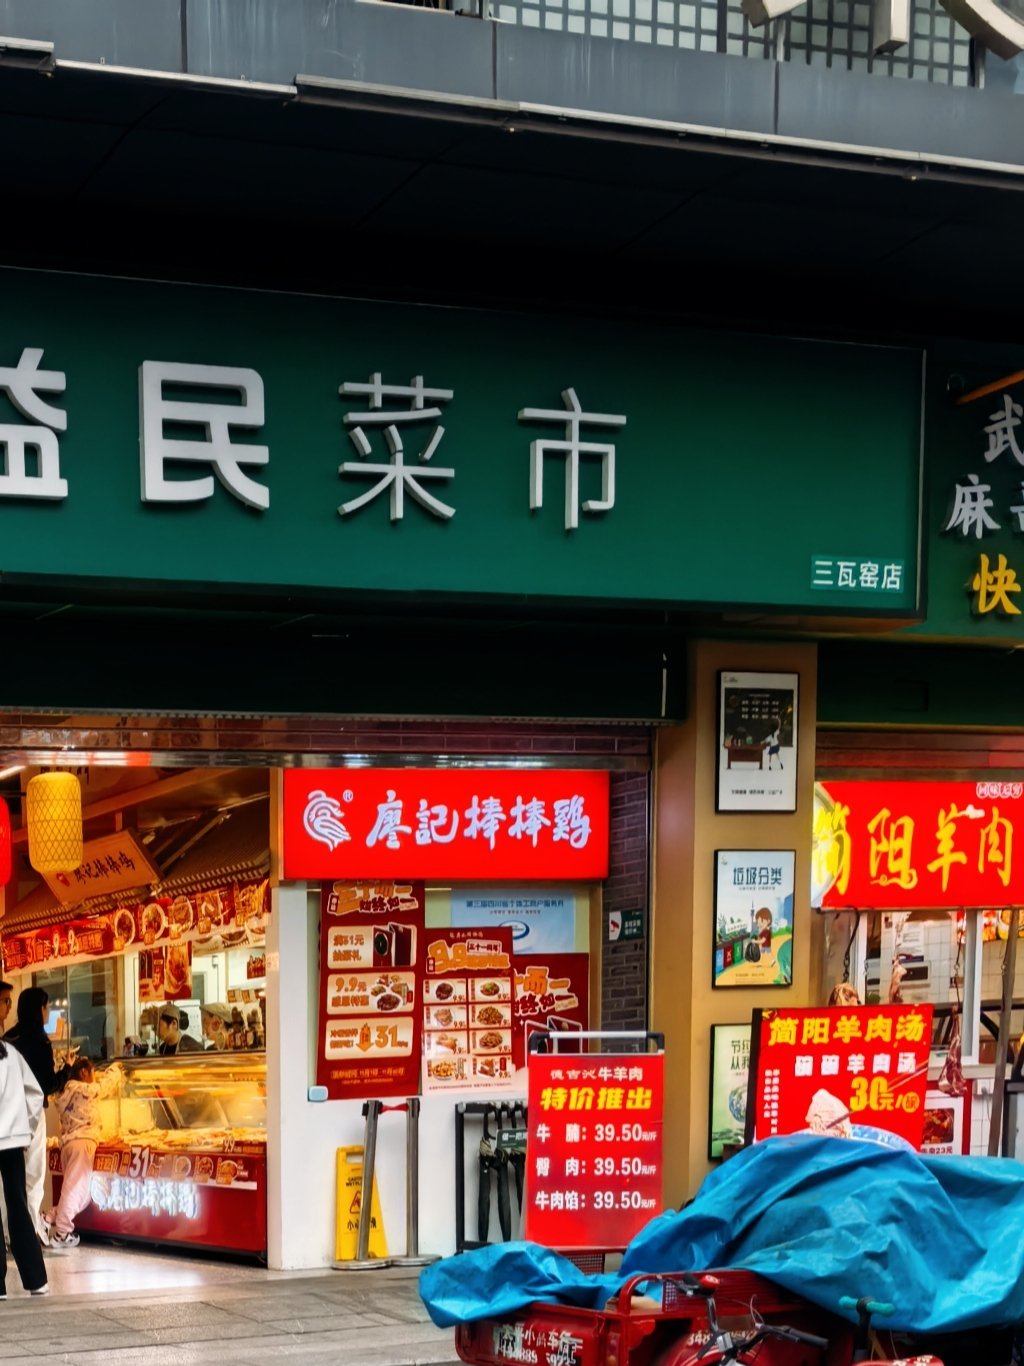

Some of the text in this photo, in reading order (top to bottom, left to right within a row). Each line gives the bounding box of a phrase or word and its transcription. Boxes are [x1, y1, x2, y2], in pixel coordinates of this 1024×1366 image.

[813, 560, 903, 589] 三瓦窑店
[733, 867, 782, 886] 垃圾分类
[768, 1014, 924, 1046] 简阳羊肉汤
[540, 1087, 652, 1110] 特价推出
